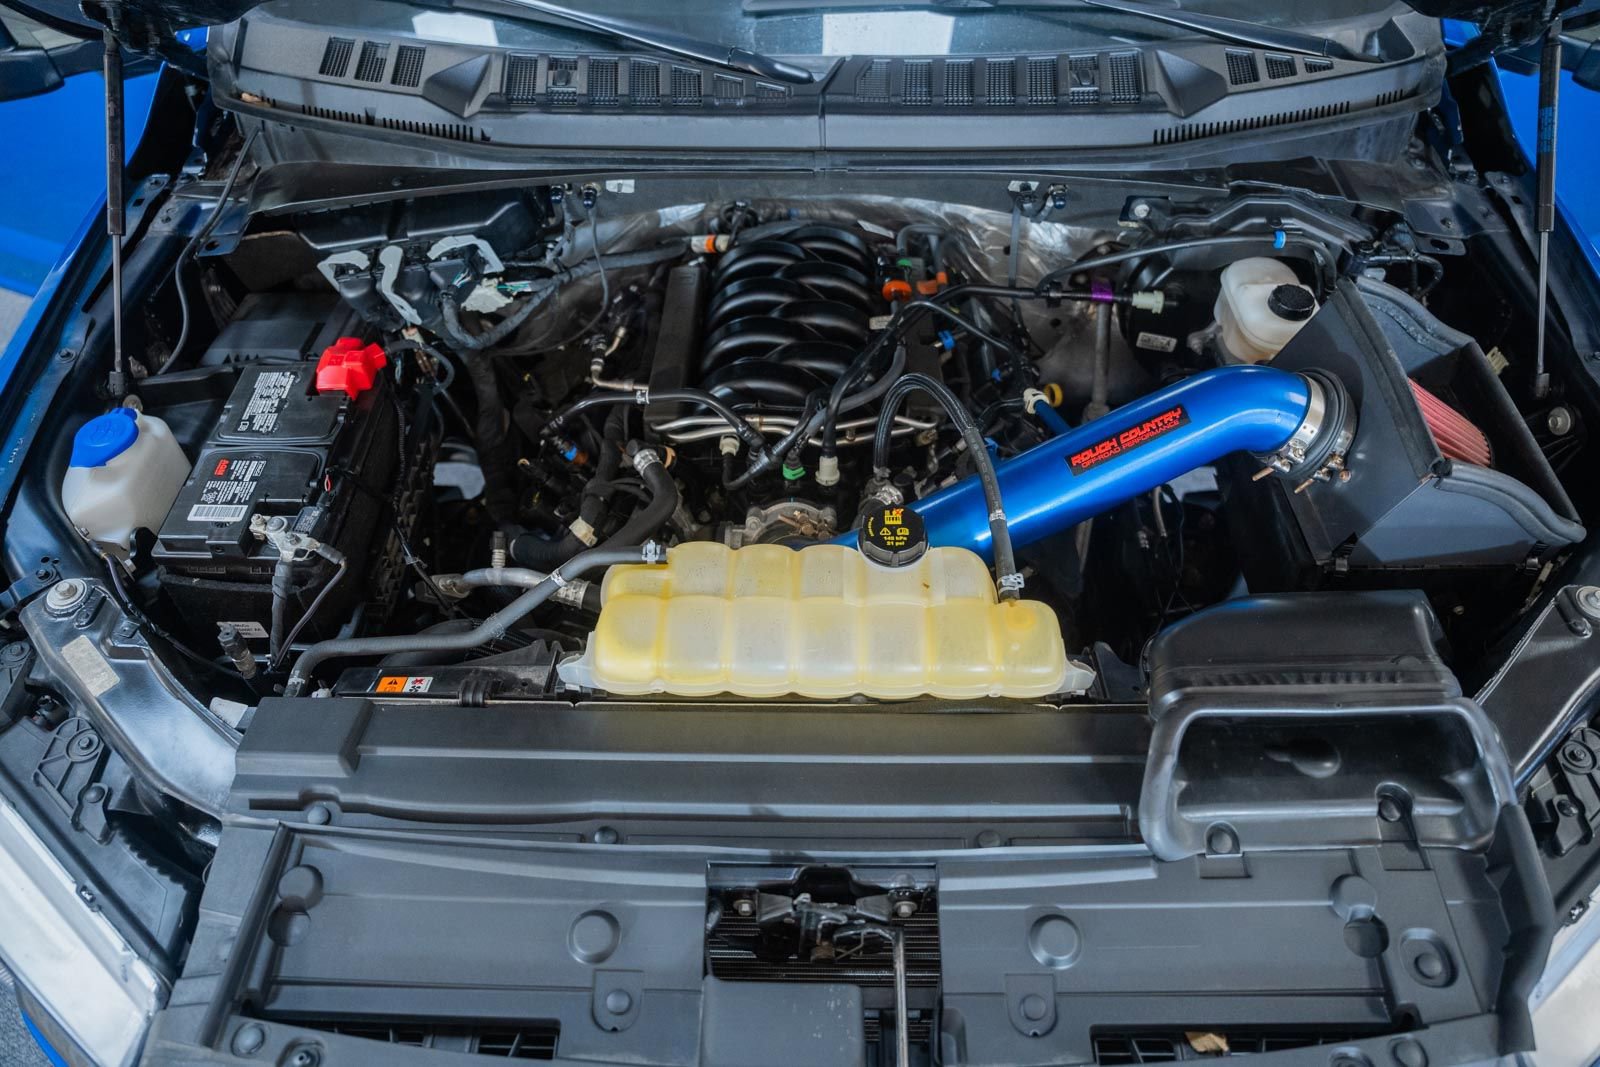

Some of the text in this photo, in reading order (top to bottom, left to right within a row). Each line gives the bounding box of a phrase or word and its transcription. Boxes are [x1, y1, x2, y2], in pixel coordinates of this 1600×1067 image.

[1071, 408, 1182, 466] ROUGH COUNTRY
[1122, 420, 1180, 449] PERFORMANCE
